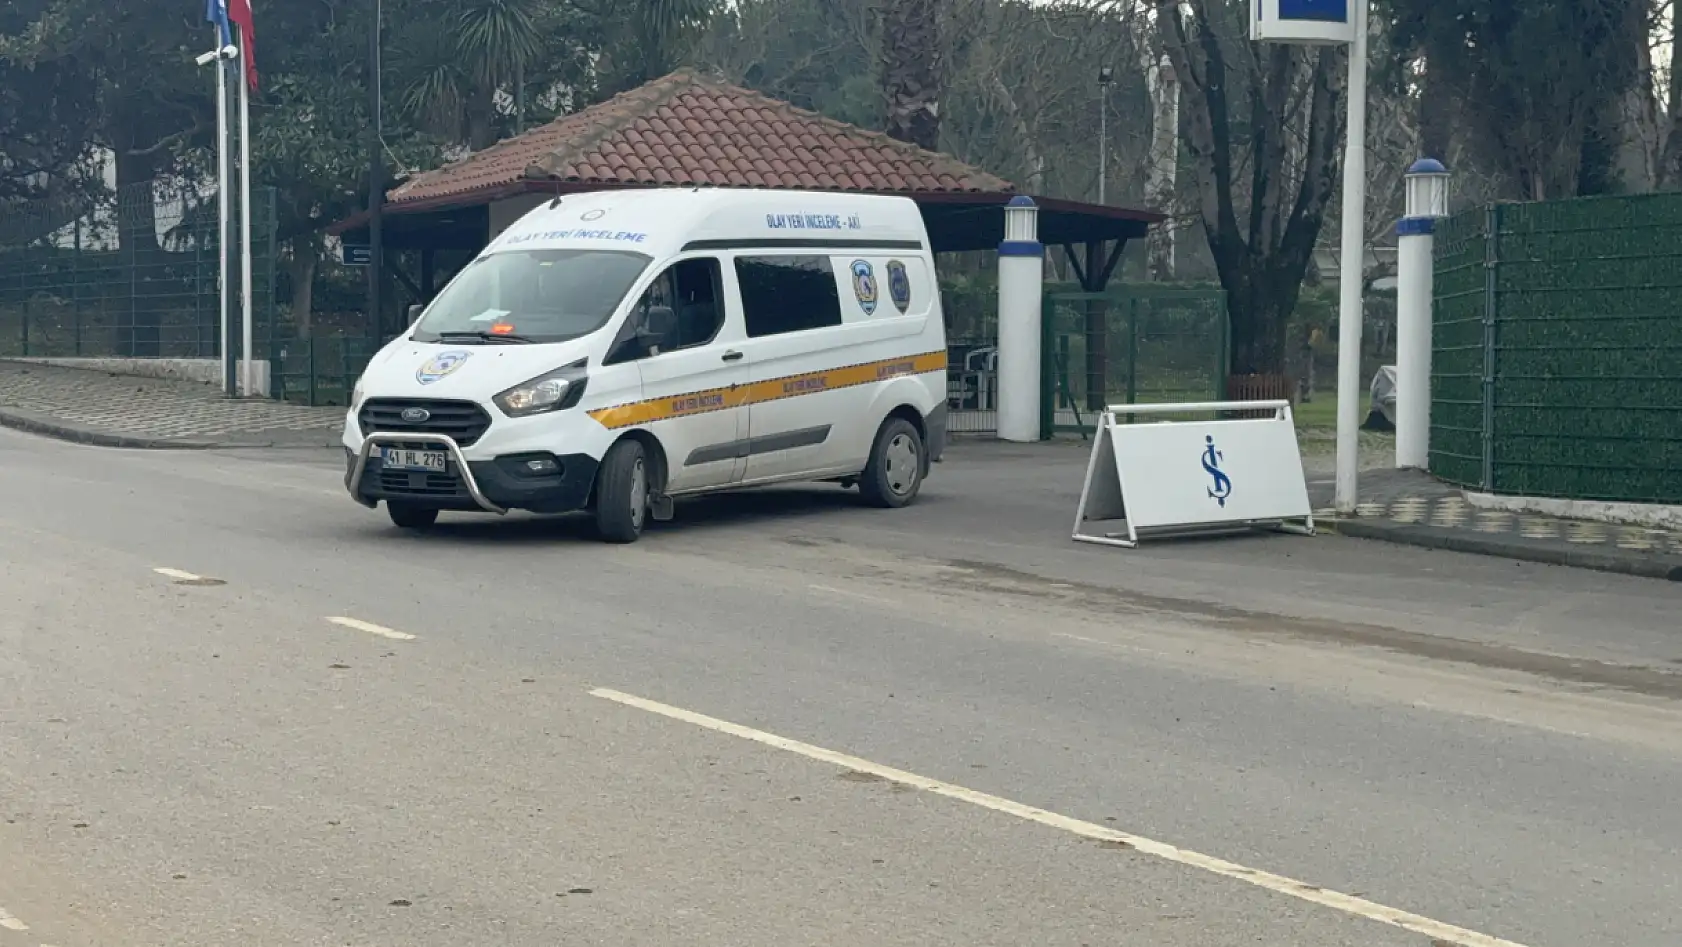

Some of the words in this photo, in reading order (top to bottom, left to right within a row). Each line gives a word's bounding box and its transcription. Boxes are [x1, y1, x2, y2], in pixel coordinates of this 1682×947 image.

[389, 450, 399, 465] 41
[404, 452, 419, 465] HL
[423, 452, 444, 467] 276
